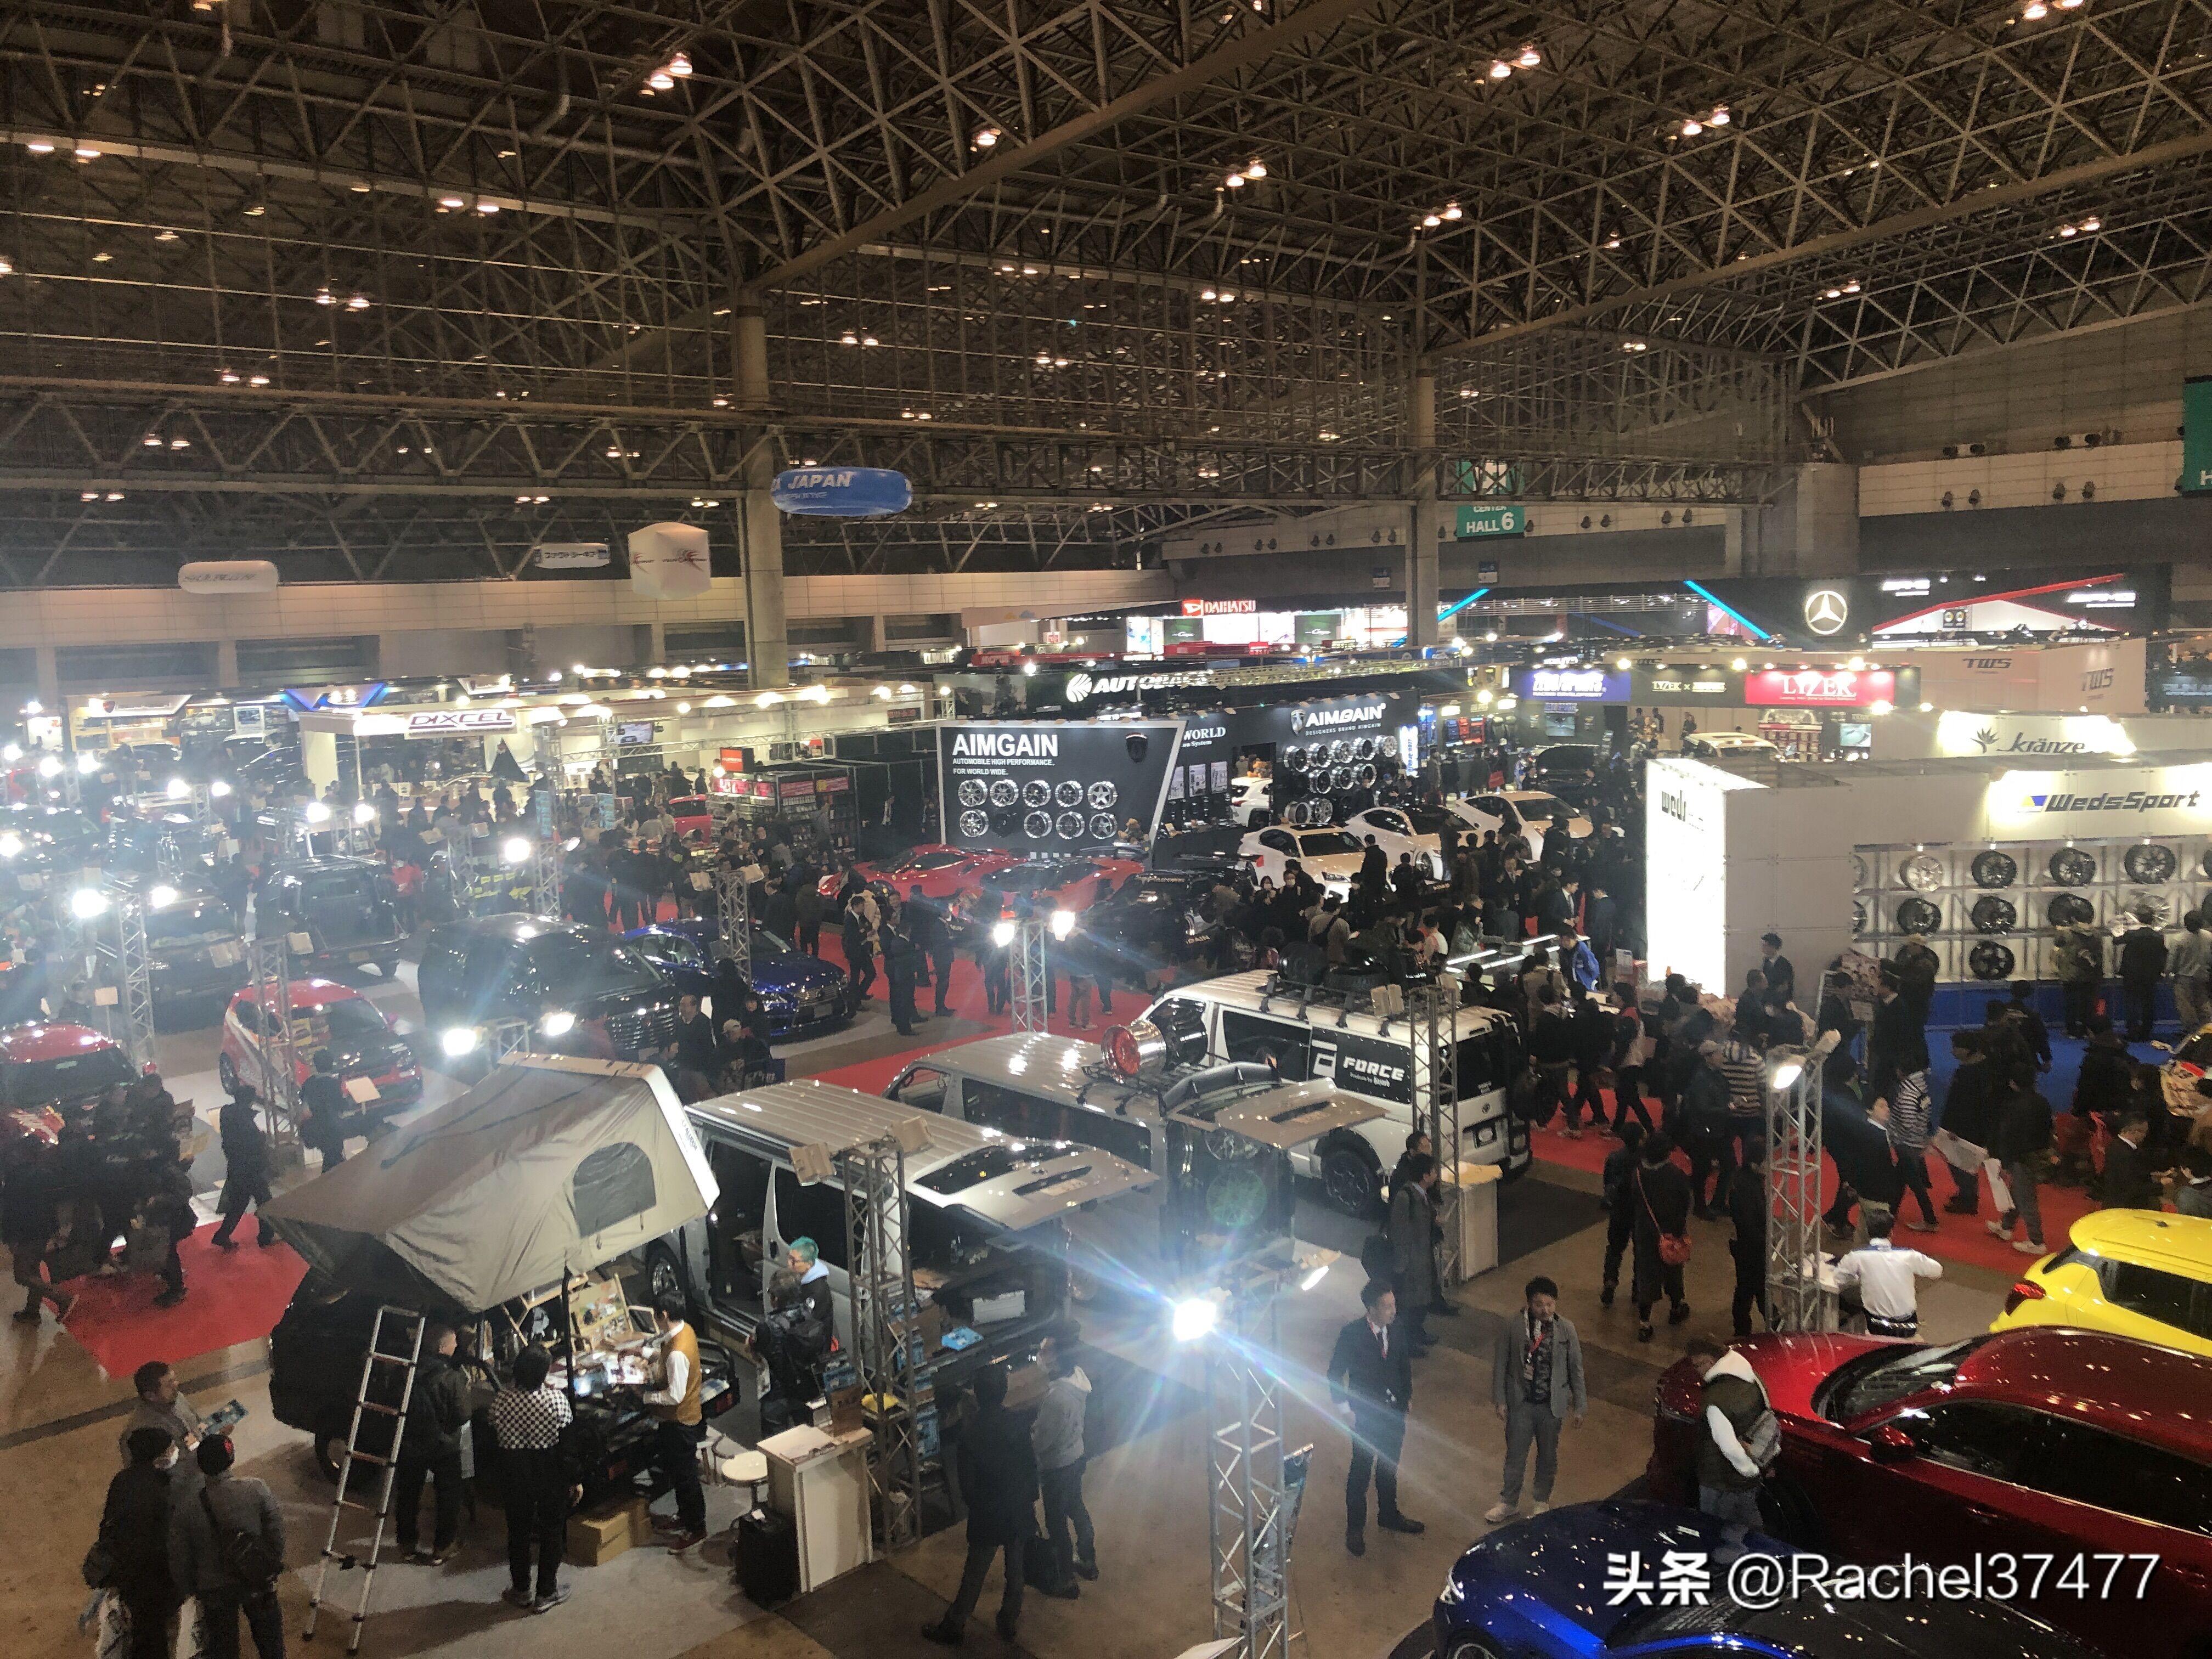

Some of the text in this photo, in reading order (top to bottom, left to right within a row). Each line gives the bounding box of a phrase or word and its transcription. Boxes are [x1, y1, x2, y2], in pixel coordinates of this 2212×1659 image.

[788, 471, 857, 489] JAPAN
[1466, 512, 1514, 533] HALL 6
[1205, 600, 1256, 613] DAIHATSU
[1962, 658, 2012, 669] TWS
[1781, 674, 1858, 697] LYZER
[2082, 668, 2115, 691] TWS
[411, 713, 511, 725] DIXCEL
[1305, 706, 1383, 727] AIMGAIN
[952, 733, 1058, 757] AIMGAIN
[2045, 790, 2200, 812] WedsSport
[1343, 1056, 1406, 1081] FORCE
